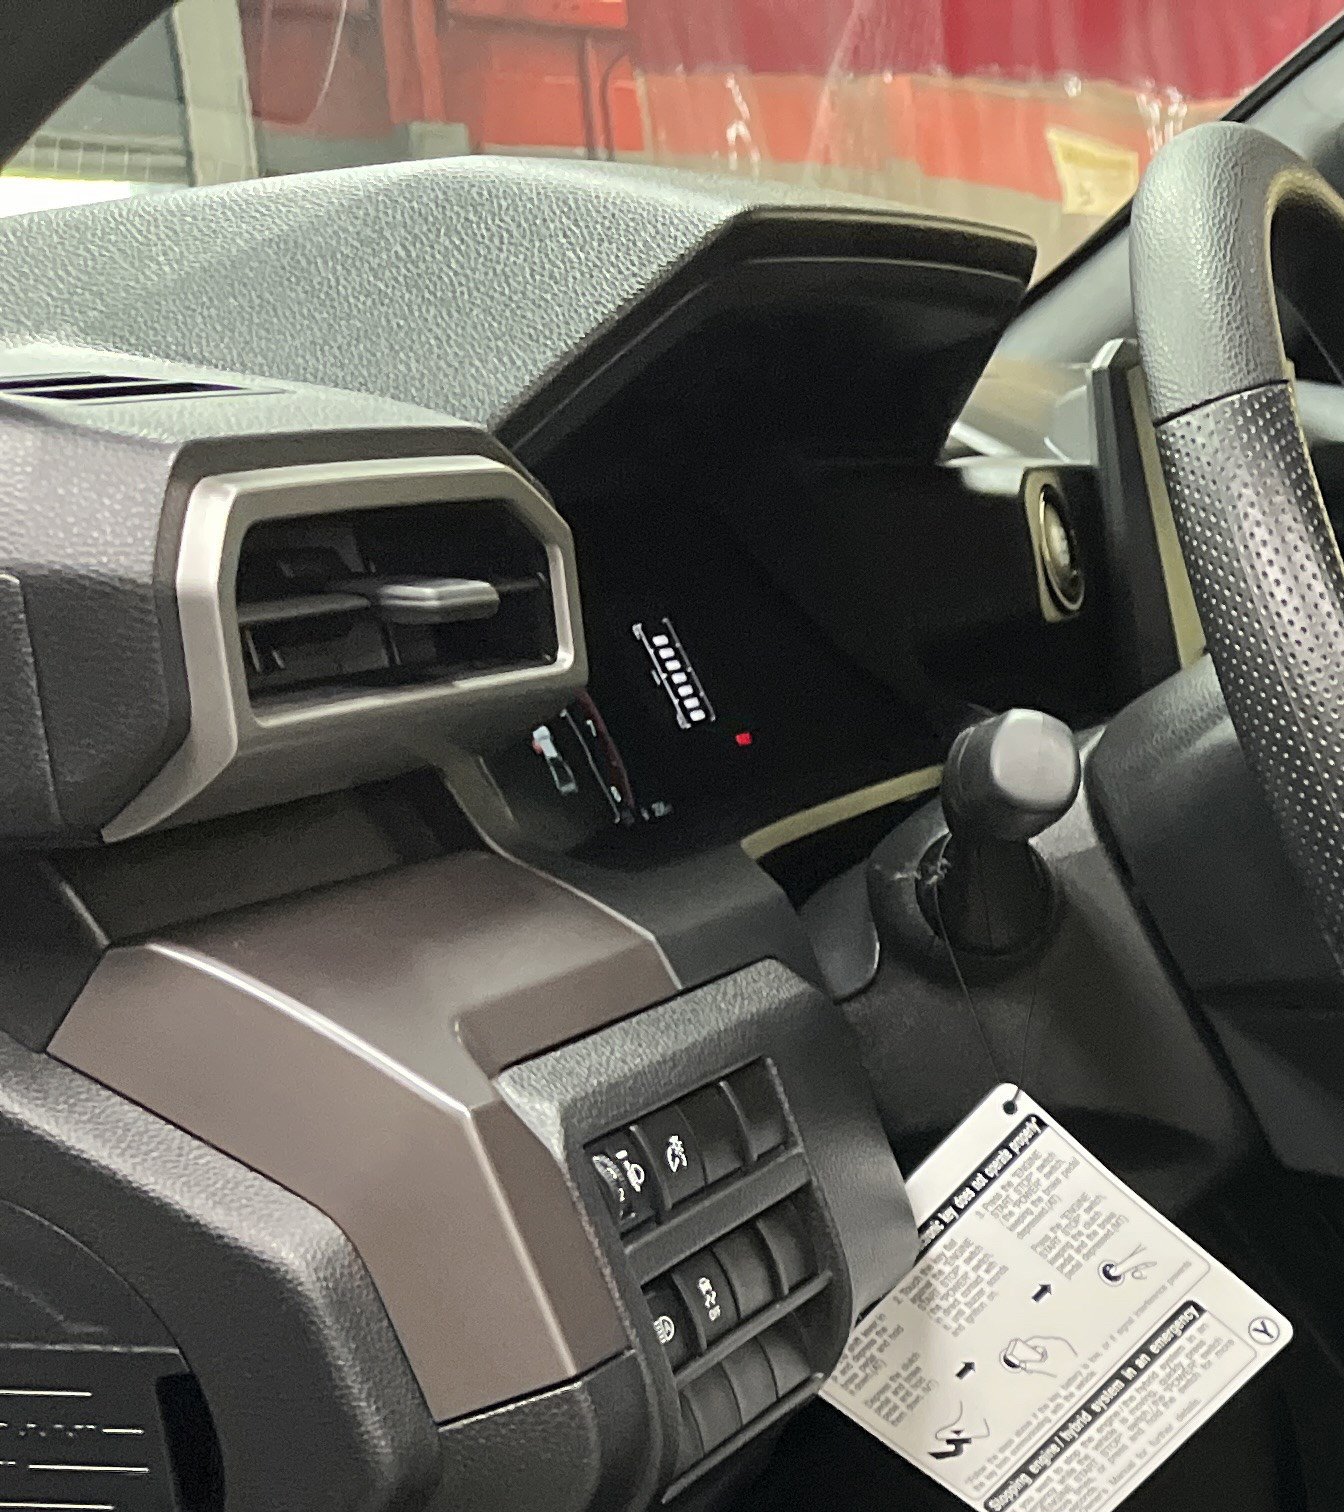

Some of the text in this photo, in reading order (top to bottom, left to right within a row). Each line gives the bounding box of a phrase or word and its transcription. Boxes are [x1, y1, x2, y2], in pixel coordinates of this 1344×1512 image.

[952, 1185, 976, 1210] does
[969, 1171, 989, 1192] not
[983, 1147, 1013, 1178] operate
[1251, 1319, 1274, 1339] Y
[987, 1471, 1033, 1512] Stopping
[1089, 1378, 1125, 1413] system
[1119, 1365, 1138, 1381] in
[1133, 1352, 1152, 1370] an
[1148, 1304, 1200, 1354] emergency
